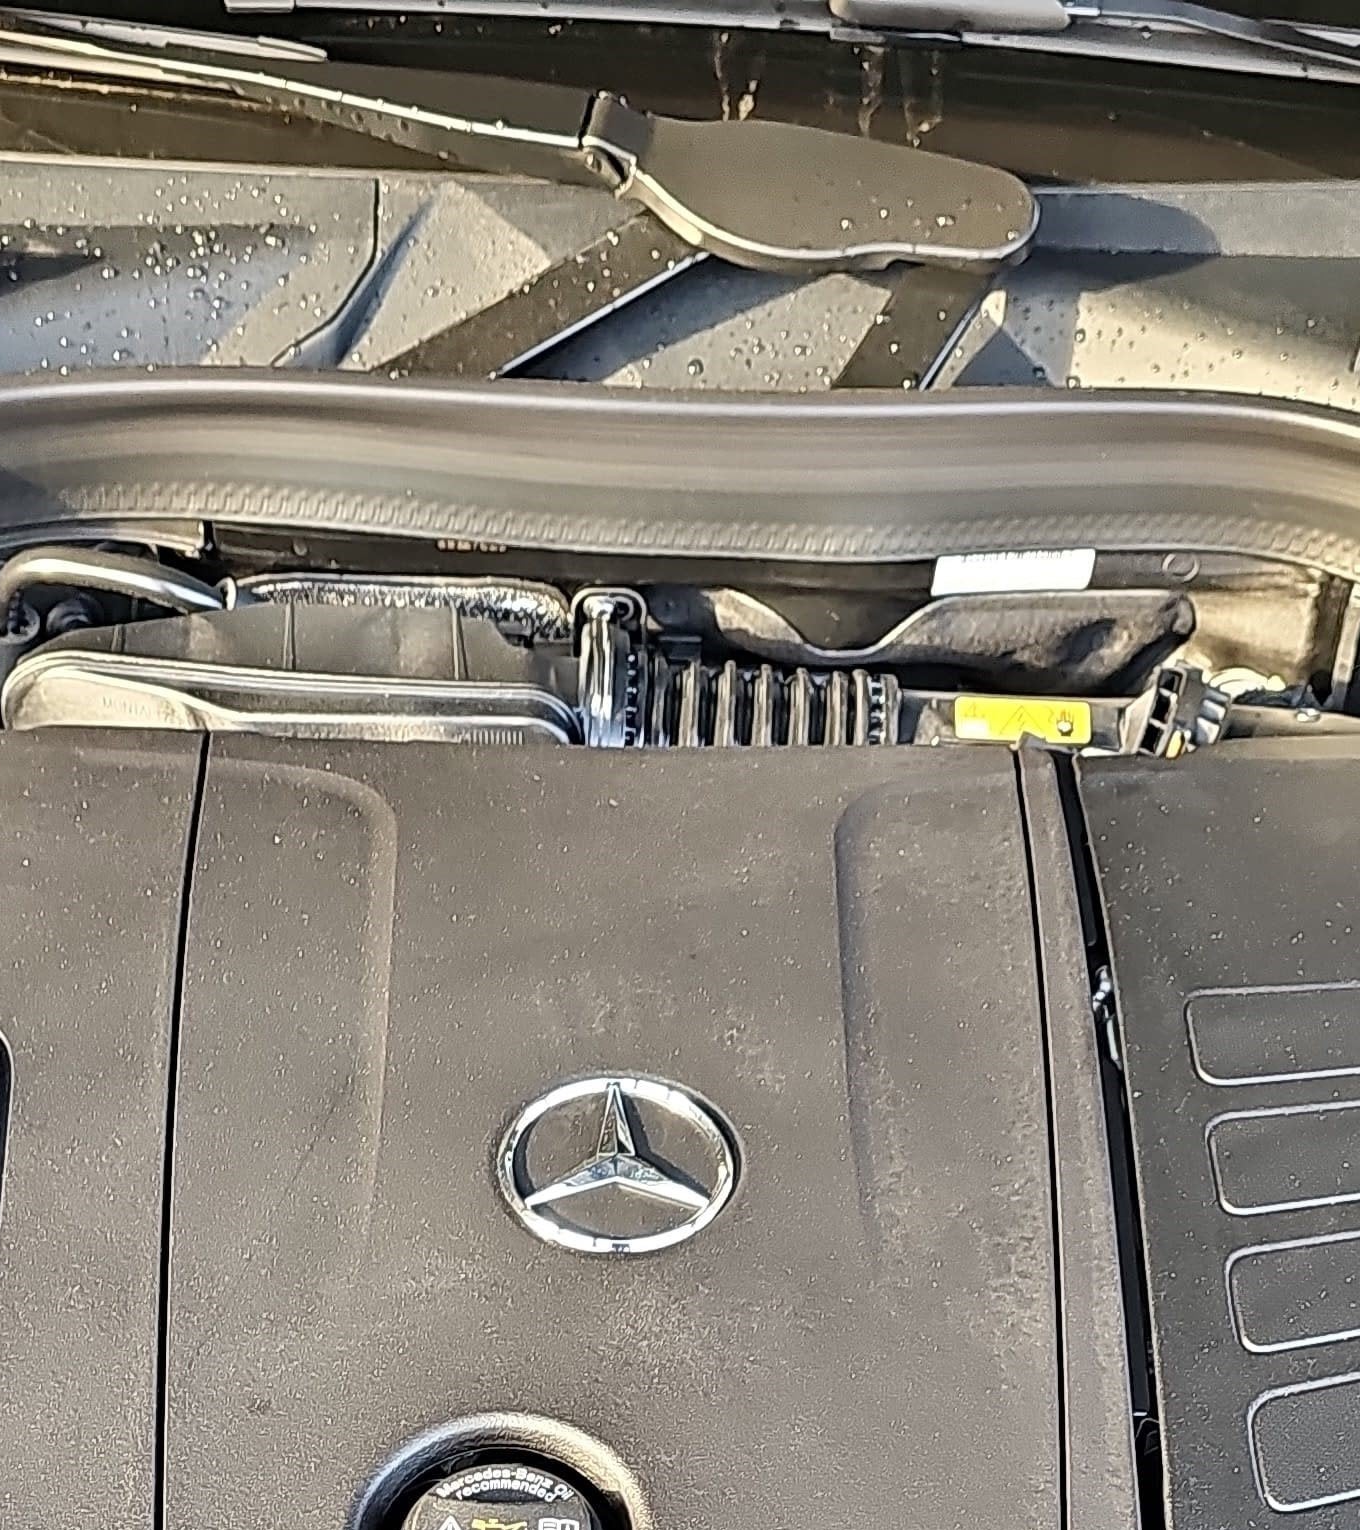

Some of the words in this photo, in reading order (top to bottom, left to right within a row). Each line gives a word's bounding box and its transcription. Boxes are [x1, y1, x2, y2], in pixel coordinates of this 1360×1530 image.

[436, 1468, 554, 1498] Mercedes-Benz
[554, 1483, 574, 1500] Oil
[456, 1478, 557, 1502] recommended
